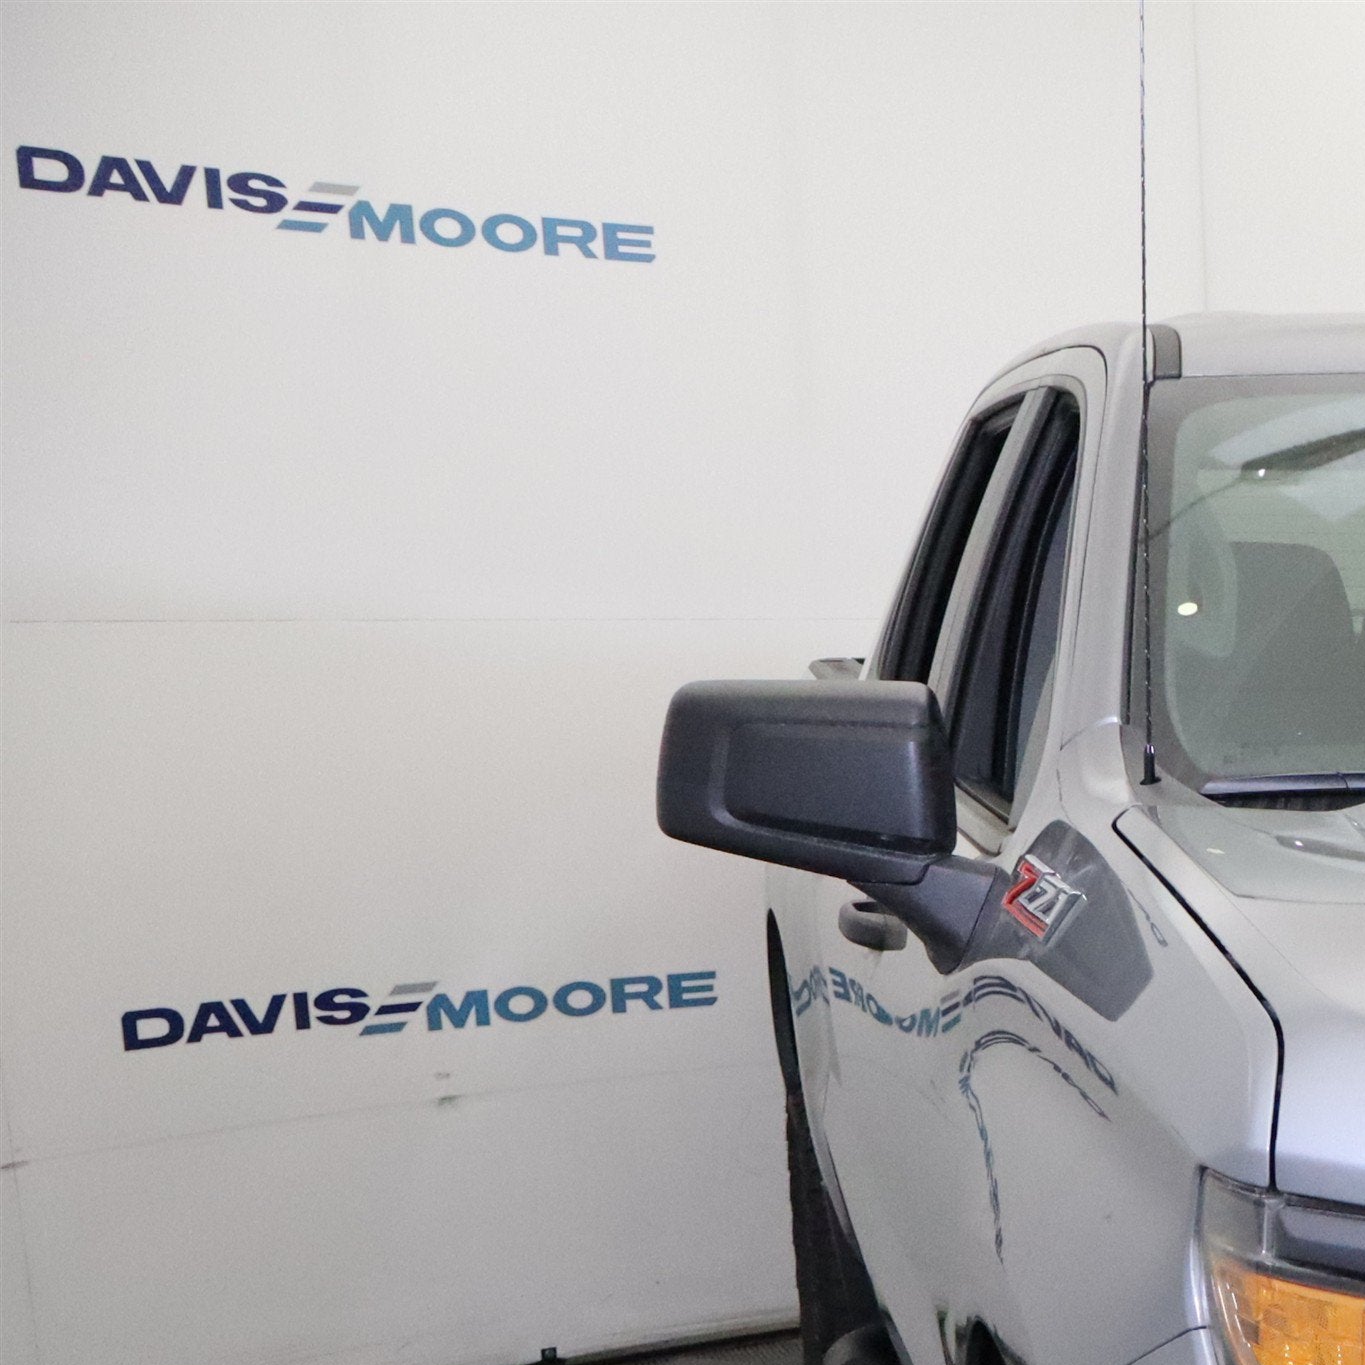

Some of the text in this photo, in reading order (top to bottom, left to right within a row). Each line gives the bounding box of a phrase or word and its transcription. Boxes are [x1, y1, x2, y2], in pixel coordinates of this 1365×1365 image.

[15, 144, 657, 263] DAVIS MOORE
[120, 970, 716, 1052] DAVIS MOORE
